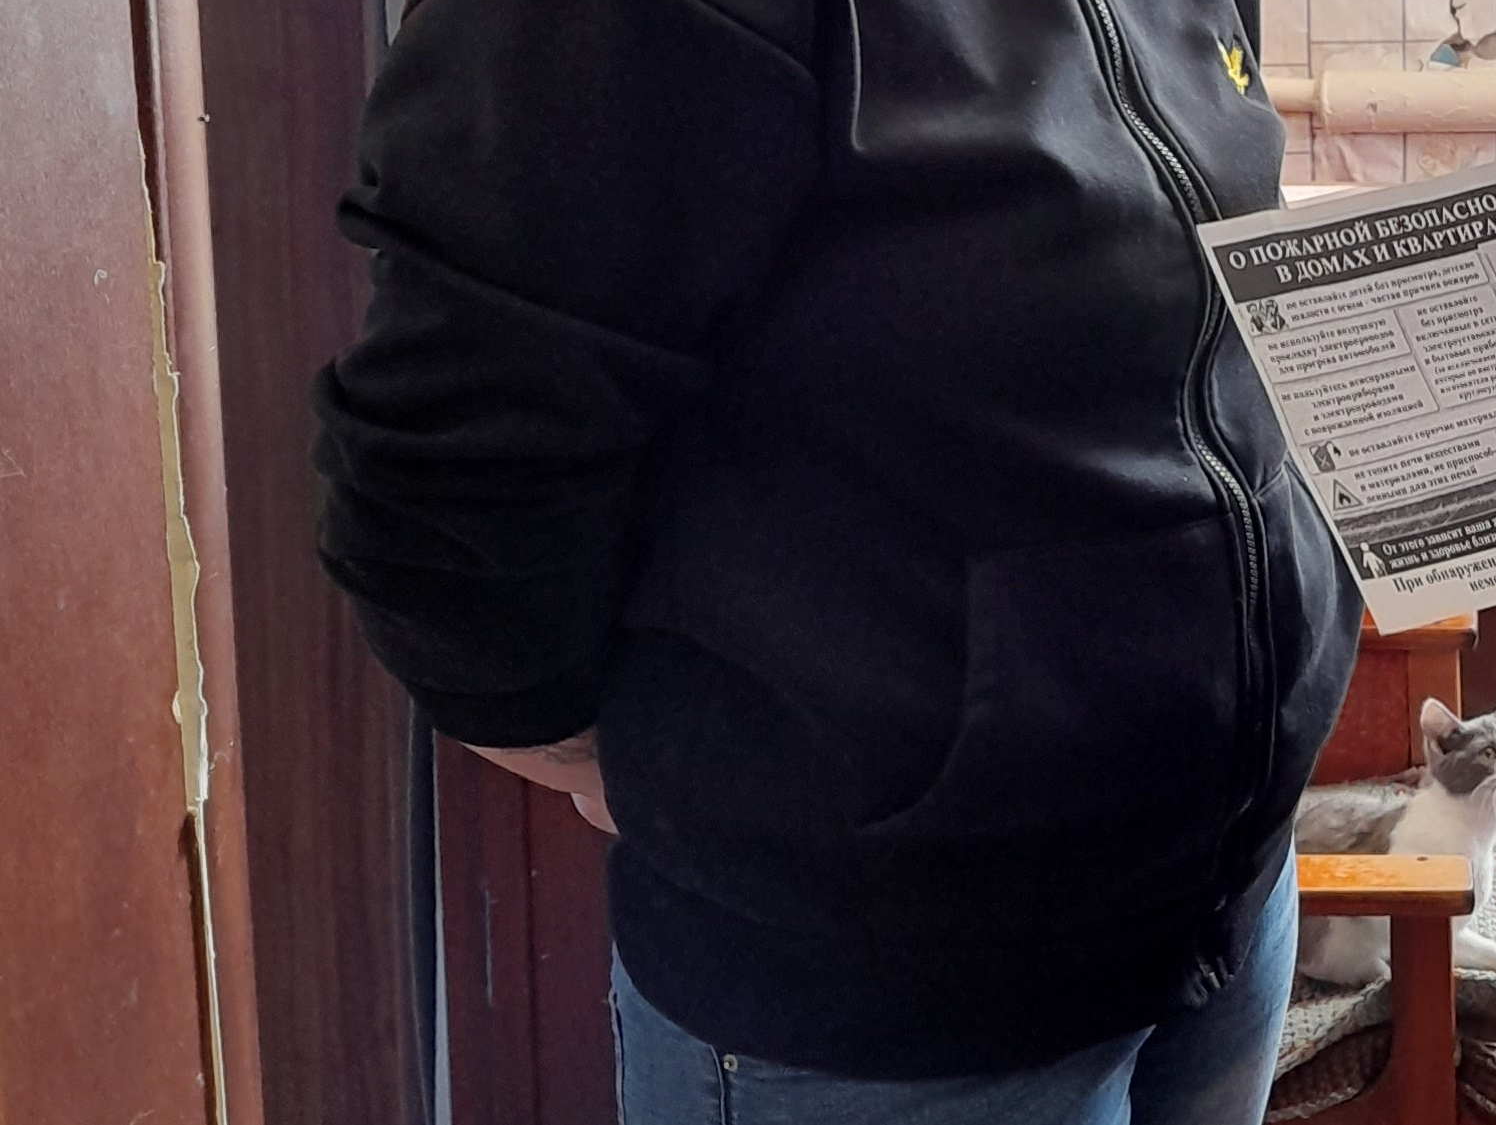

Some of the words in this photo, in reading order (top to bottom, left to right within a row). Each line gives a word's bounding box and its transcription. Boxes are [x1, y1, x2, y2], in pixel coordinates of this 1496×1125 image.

[1229, 251, 1246, 268] О
[1249, 221, 1371, 264] ПОЖАРНОЙ
[1275, 264, 1292, 283] В
[1295, 248, 1370, 281] ДОМАХ
[1371, 243, 1390, 262] И
[1393, 577, 1423, 591] При
